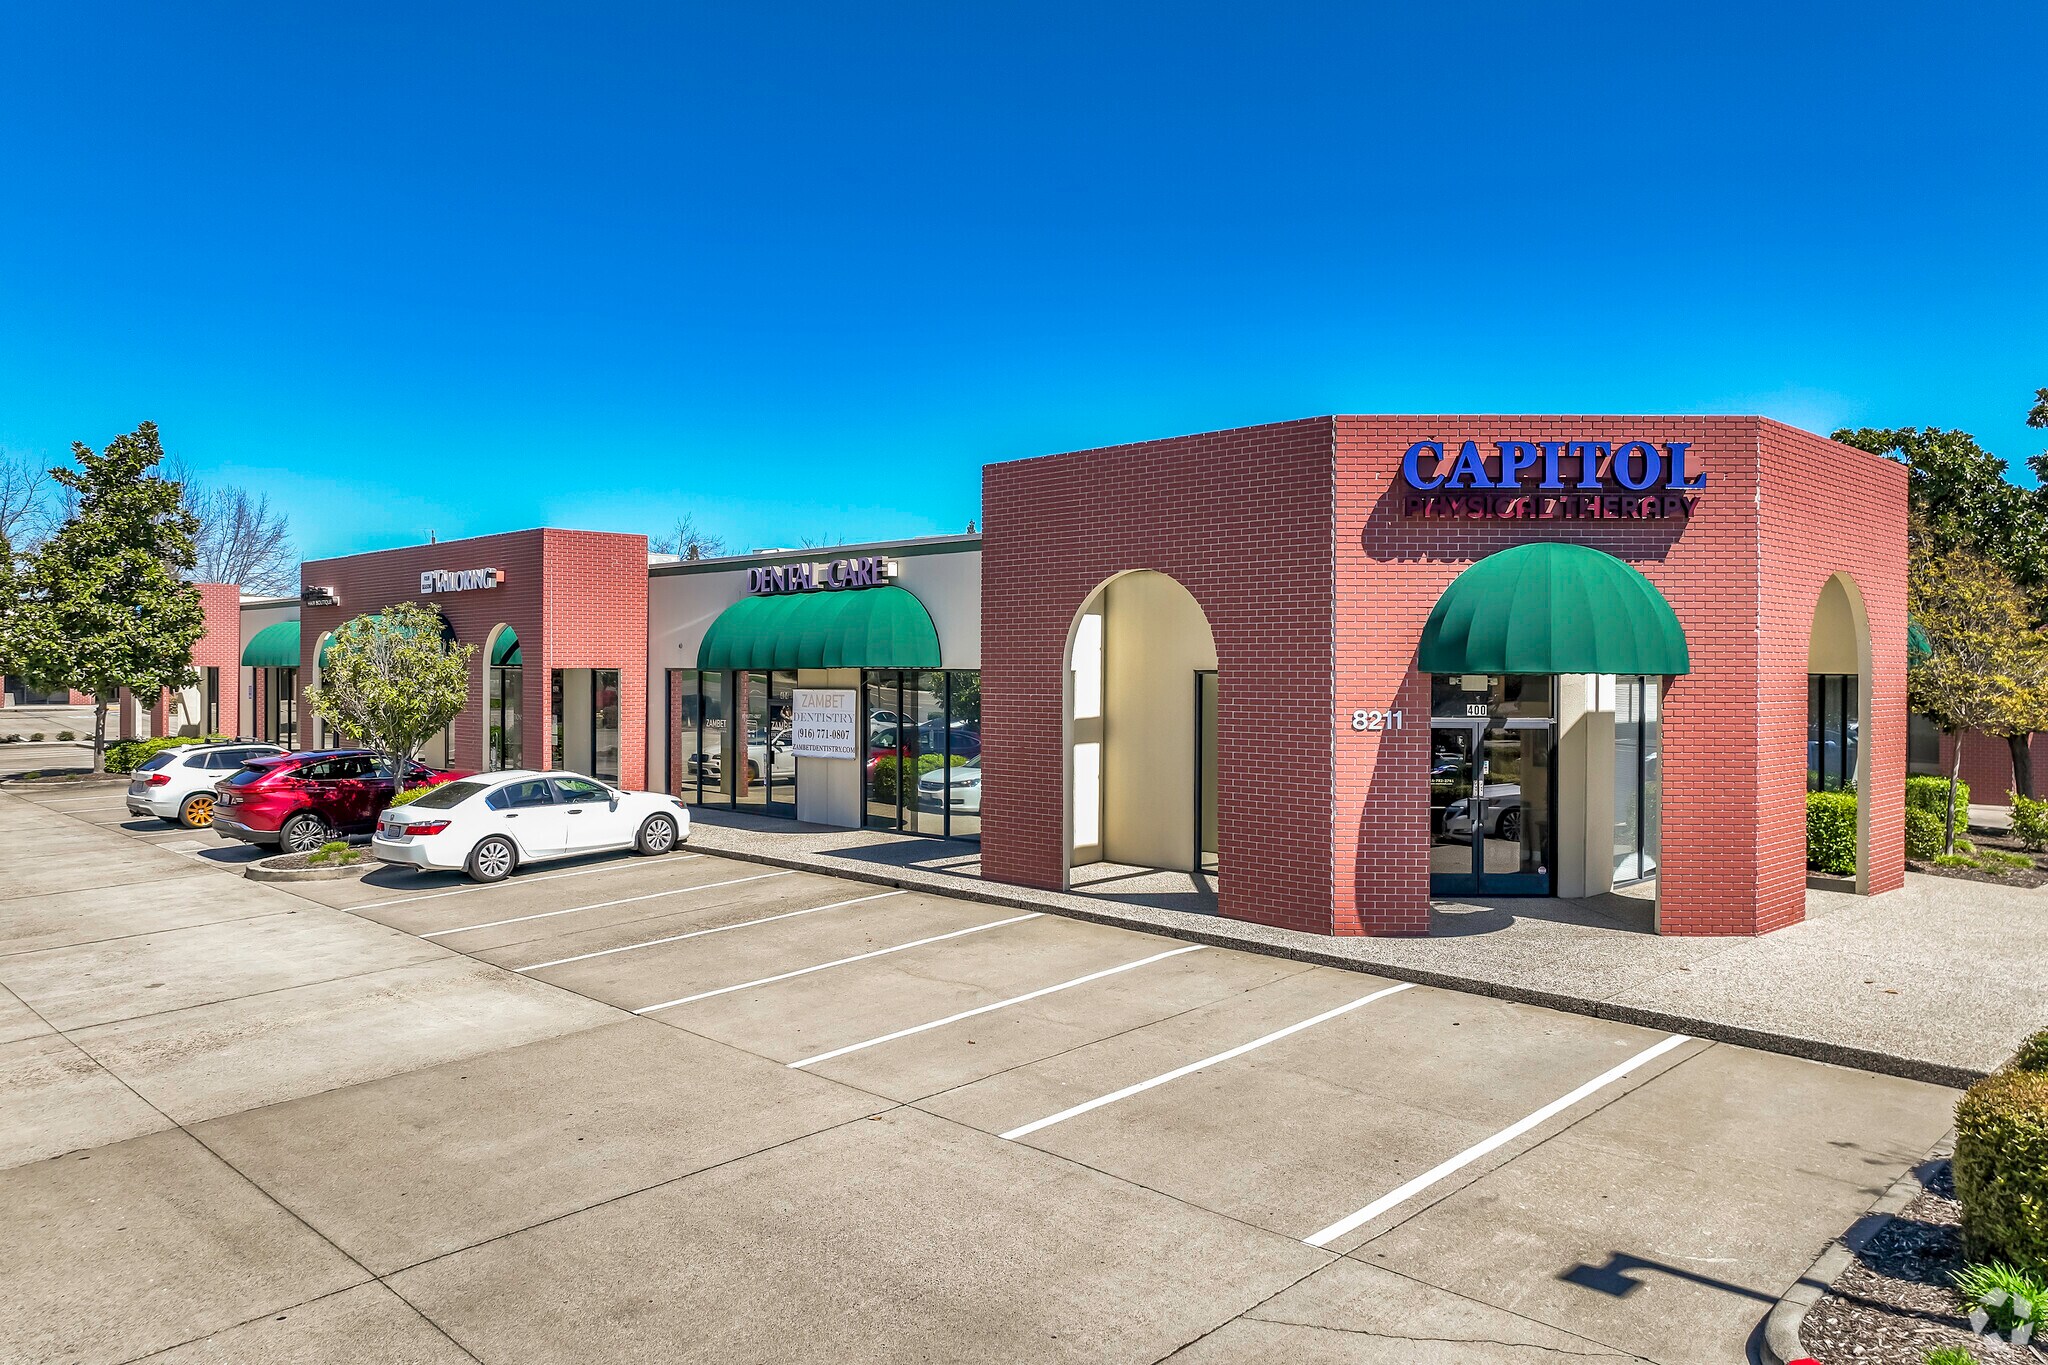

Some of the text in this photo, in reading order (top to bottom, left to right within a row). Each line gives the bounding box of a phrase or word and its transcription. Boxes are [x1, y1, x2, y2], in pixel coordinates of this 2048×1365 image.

[1402, 440, 1707, 490] CAPITOL
[1404, 495, 1702, 519] PHYSICAL THERAPY
[433, 568, 493, 593] TAILORING
[746, 556, 885, 593] DENTAL CARE
[801, 694, 845, 709] ZAMBET
[1467, 704, 1486, 716] 400
[705, 718, 727, 728] ZAMBET
[793, 712, 855, 724] DENTISTRY
[1352, 710, 1403, 731] 8211
[770, 720, 793, 731] ZAMBE
[797, 728, 815, 740] (916)
[816, 728, 850, 740] 771-0807
[792, 743, 855, 754] ZAMBETDENTISTRY.COM
